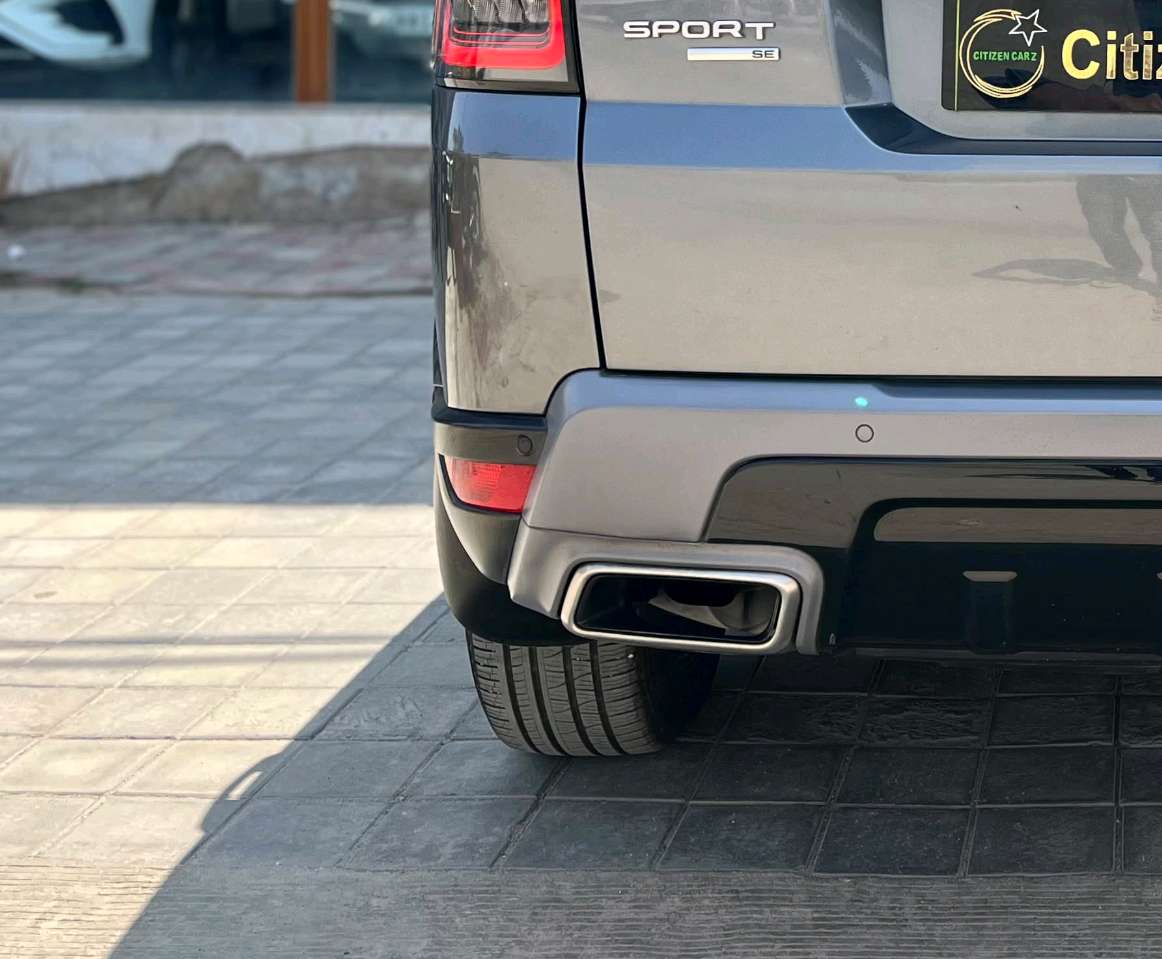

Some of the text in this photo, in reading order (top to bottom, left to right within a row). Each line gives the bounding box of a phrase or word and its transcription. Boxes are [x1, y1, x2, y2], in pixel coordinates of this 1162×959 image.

[622, 20, 776, 40] SPORT
[751, 49, 776, 59] SE
[973, 50, 1038, 62] CITIZEN CARZ
